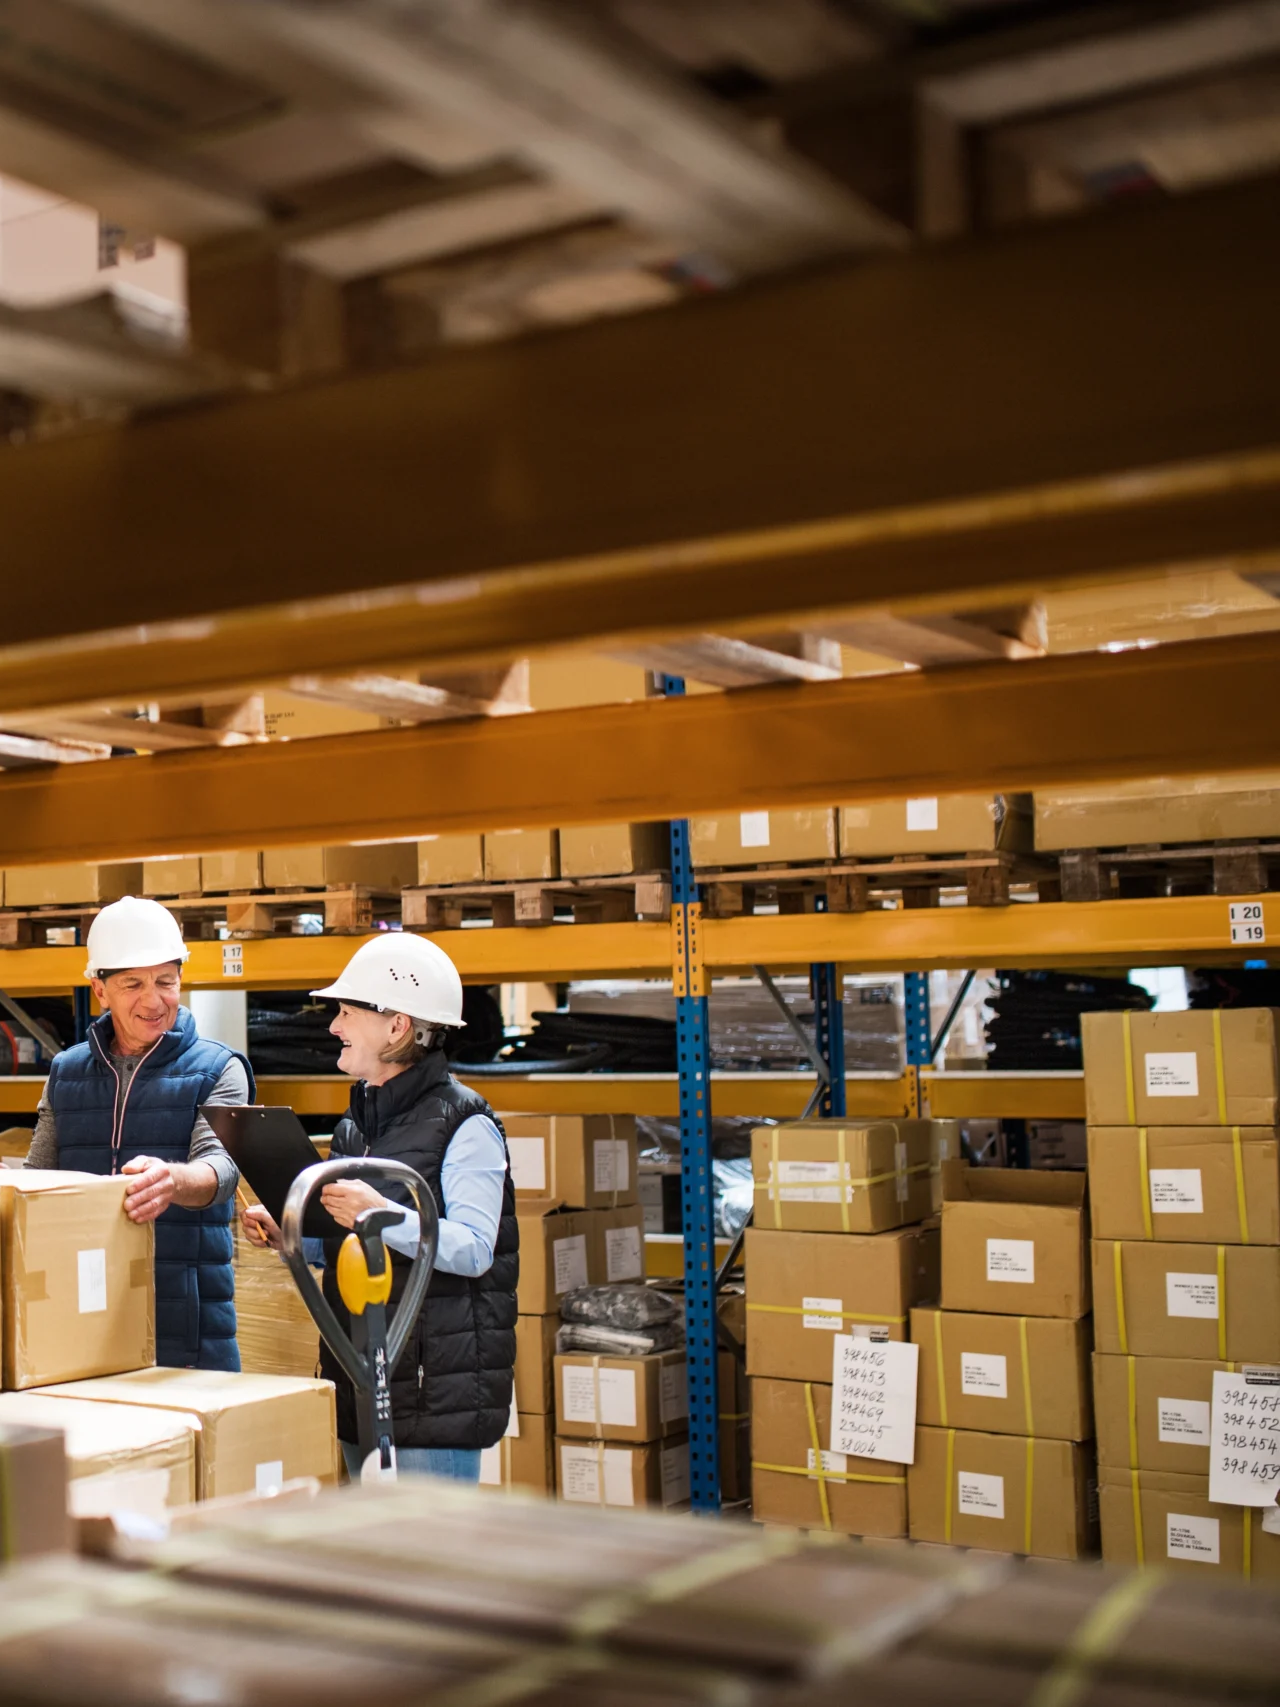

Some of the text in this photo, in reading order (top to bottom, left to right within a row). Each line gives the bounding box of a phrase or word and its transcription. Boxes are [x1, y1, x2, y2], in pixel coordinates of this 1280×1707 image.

[1243, 906, 1262, 919] 20
[1245, 926, 1263, 939] 19
[231, 947, 241, 957] 17
[232, 963, 242, 974] 18
[842, 1384, 886, 1403] 398462
[841, 1401, 884, 1421] 398469
[839, 1419, 892, 1439] 23045
[1223, 1412, 1280, 1432] 398452
[841, 1437, 876, 1455] 38004
[1221, 1433, 1278, 1455] 398454
[1221, 1457, 1280, 1480] 398459
